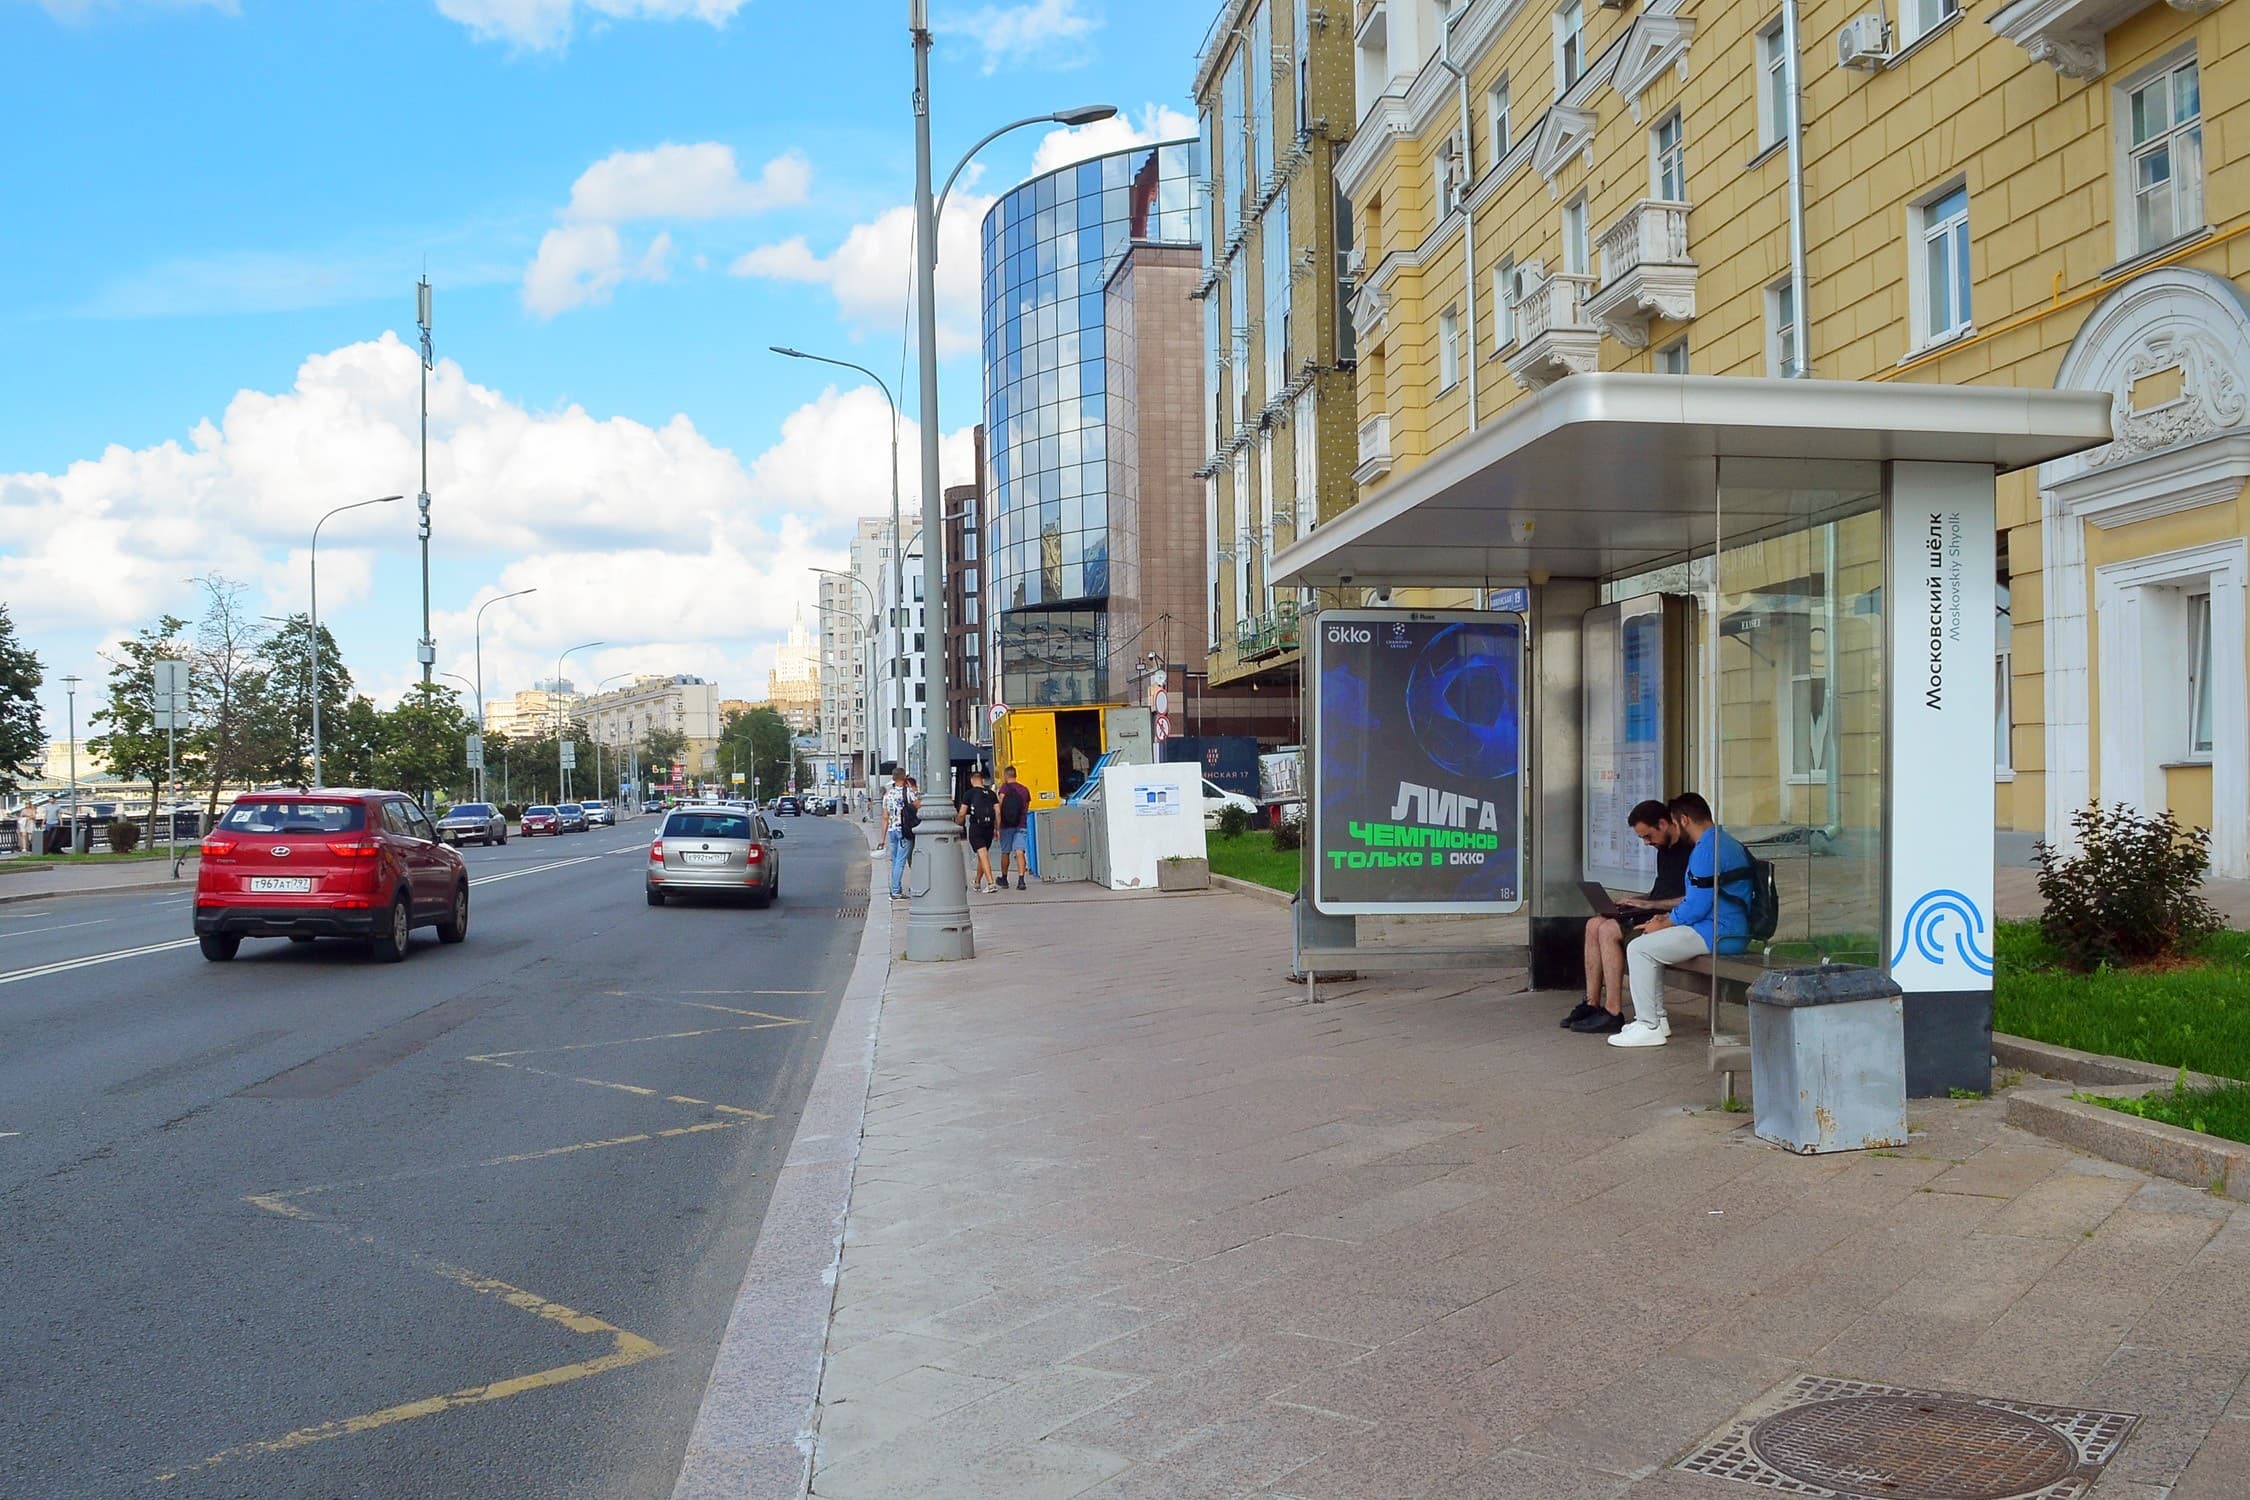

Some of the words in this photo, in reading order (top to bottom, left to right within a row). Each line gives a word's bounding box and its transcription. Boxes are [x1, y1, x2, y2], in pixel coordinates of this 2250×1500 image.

[1926, 512, 1942, 568] шёлк
[1949, 512, 1962, 556] Shyolk
[1949, 560, 1962, 642] Moskovskiy
[1926, 577, 1942, 710] Московский
[1391, 781, 1498, 832] ЛИГА
[1349, 821, 1498, 850] ЧЕМПИОНОВ
[1327, 851, 1424, 870] ТОЛЬКО
[1431, 852, 1443, 866] В
[1500, 887, 1515, 900] 18+
